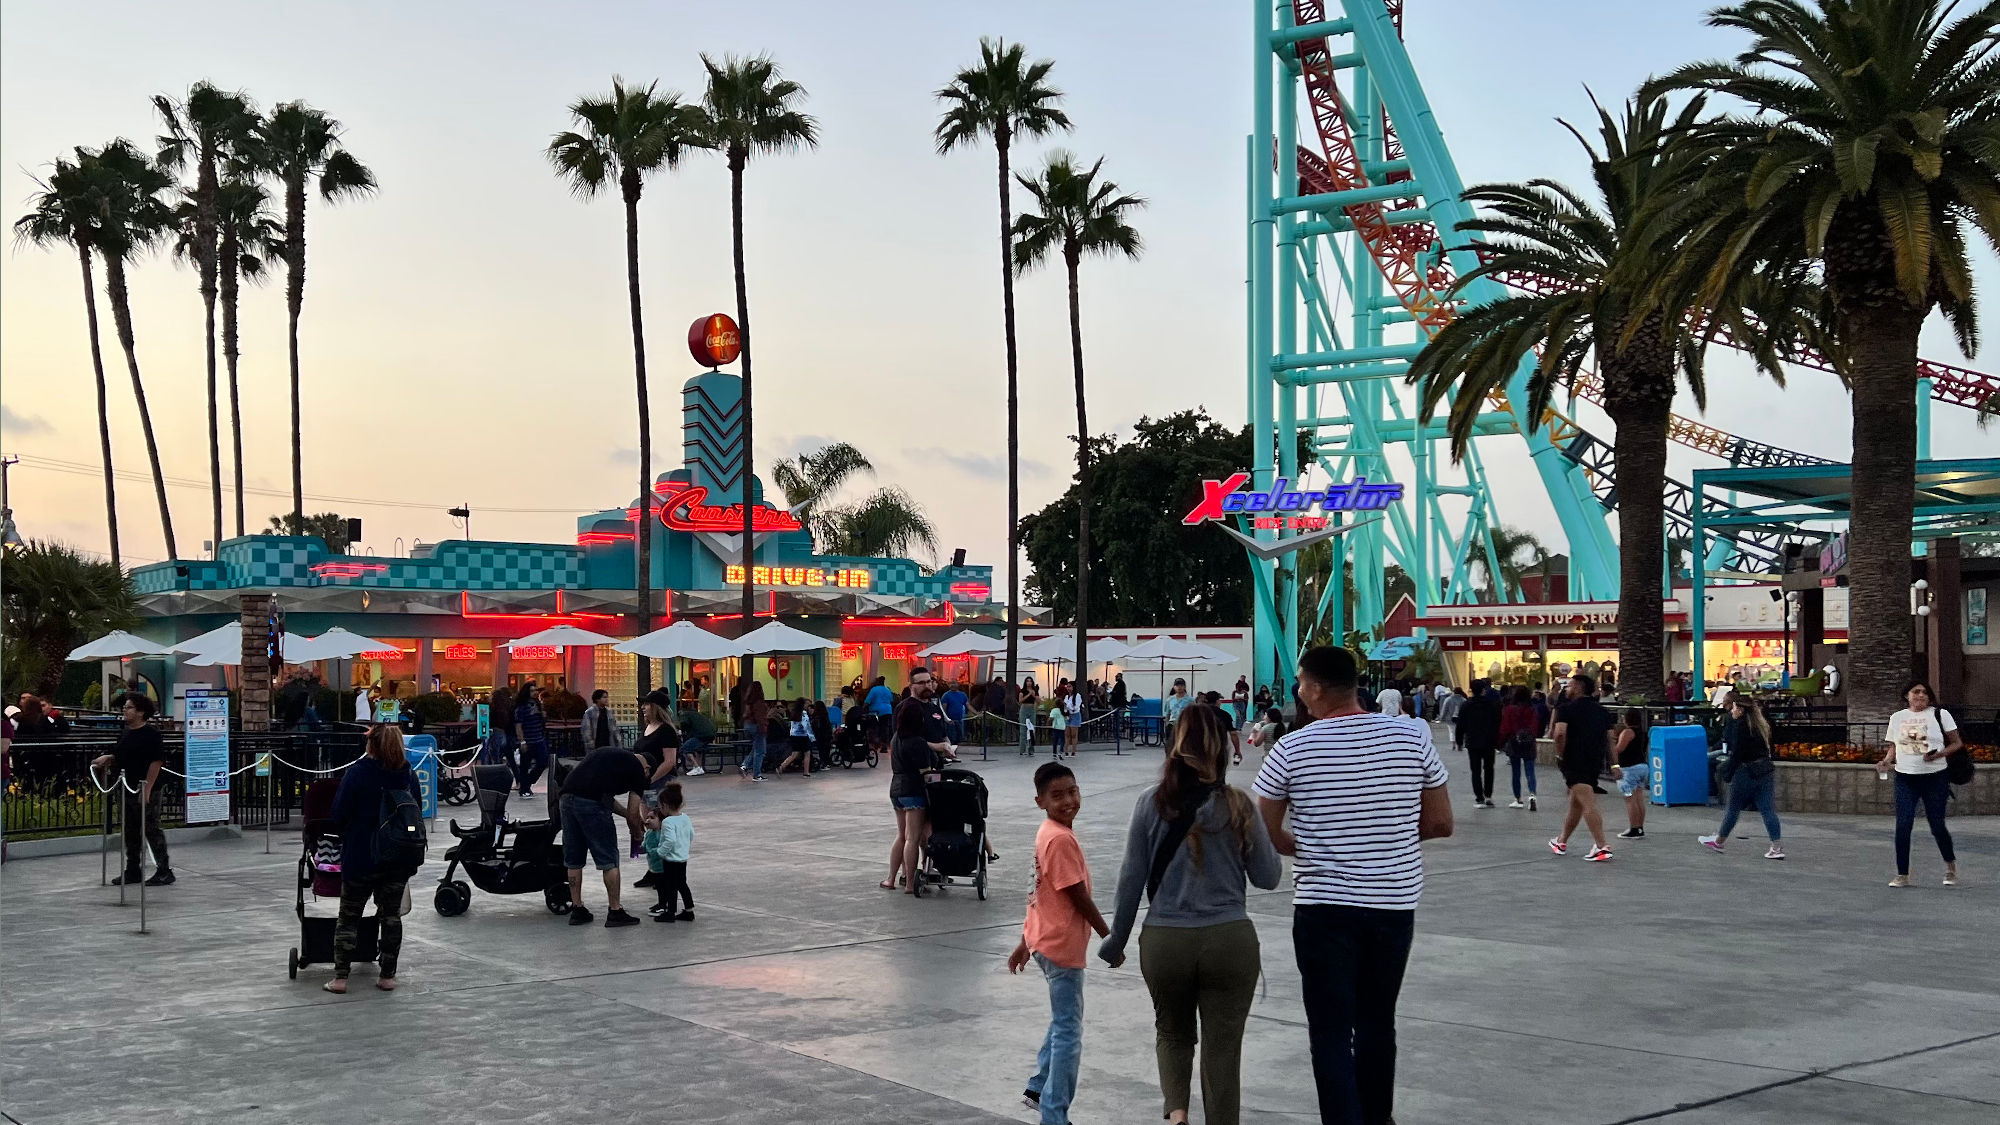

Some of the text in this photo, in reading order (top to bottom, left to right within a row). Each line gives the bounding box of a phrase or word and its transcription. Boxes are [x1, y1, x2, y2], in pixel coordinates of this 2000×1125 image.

[1182, 472, 1404, 525] Xcelerator
[1256, 516, 1329, 529] RIDE ENTRY
[726, 565, 869, 587] DRIVE-IN
[1451, 612, 1617, 626] LEE'S LAST STOP SERV
[447, 647, 474, 658] FRIES
[514, 647, 555, 658] BURGERS
